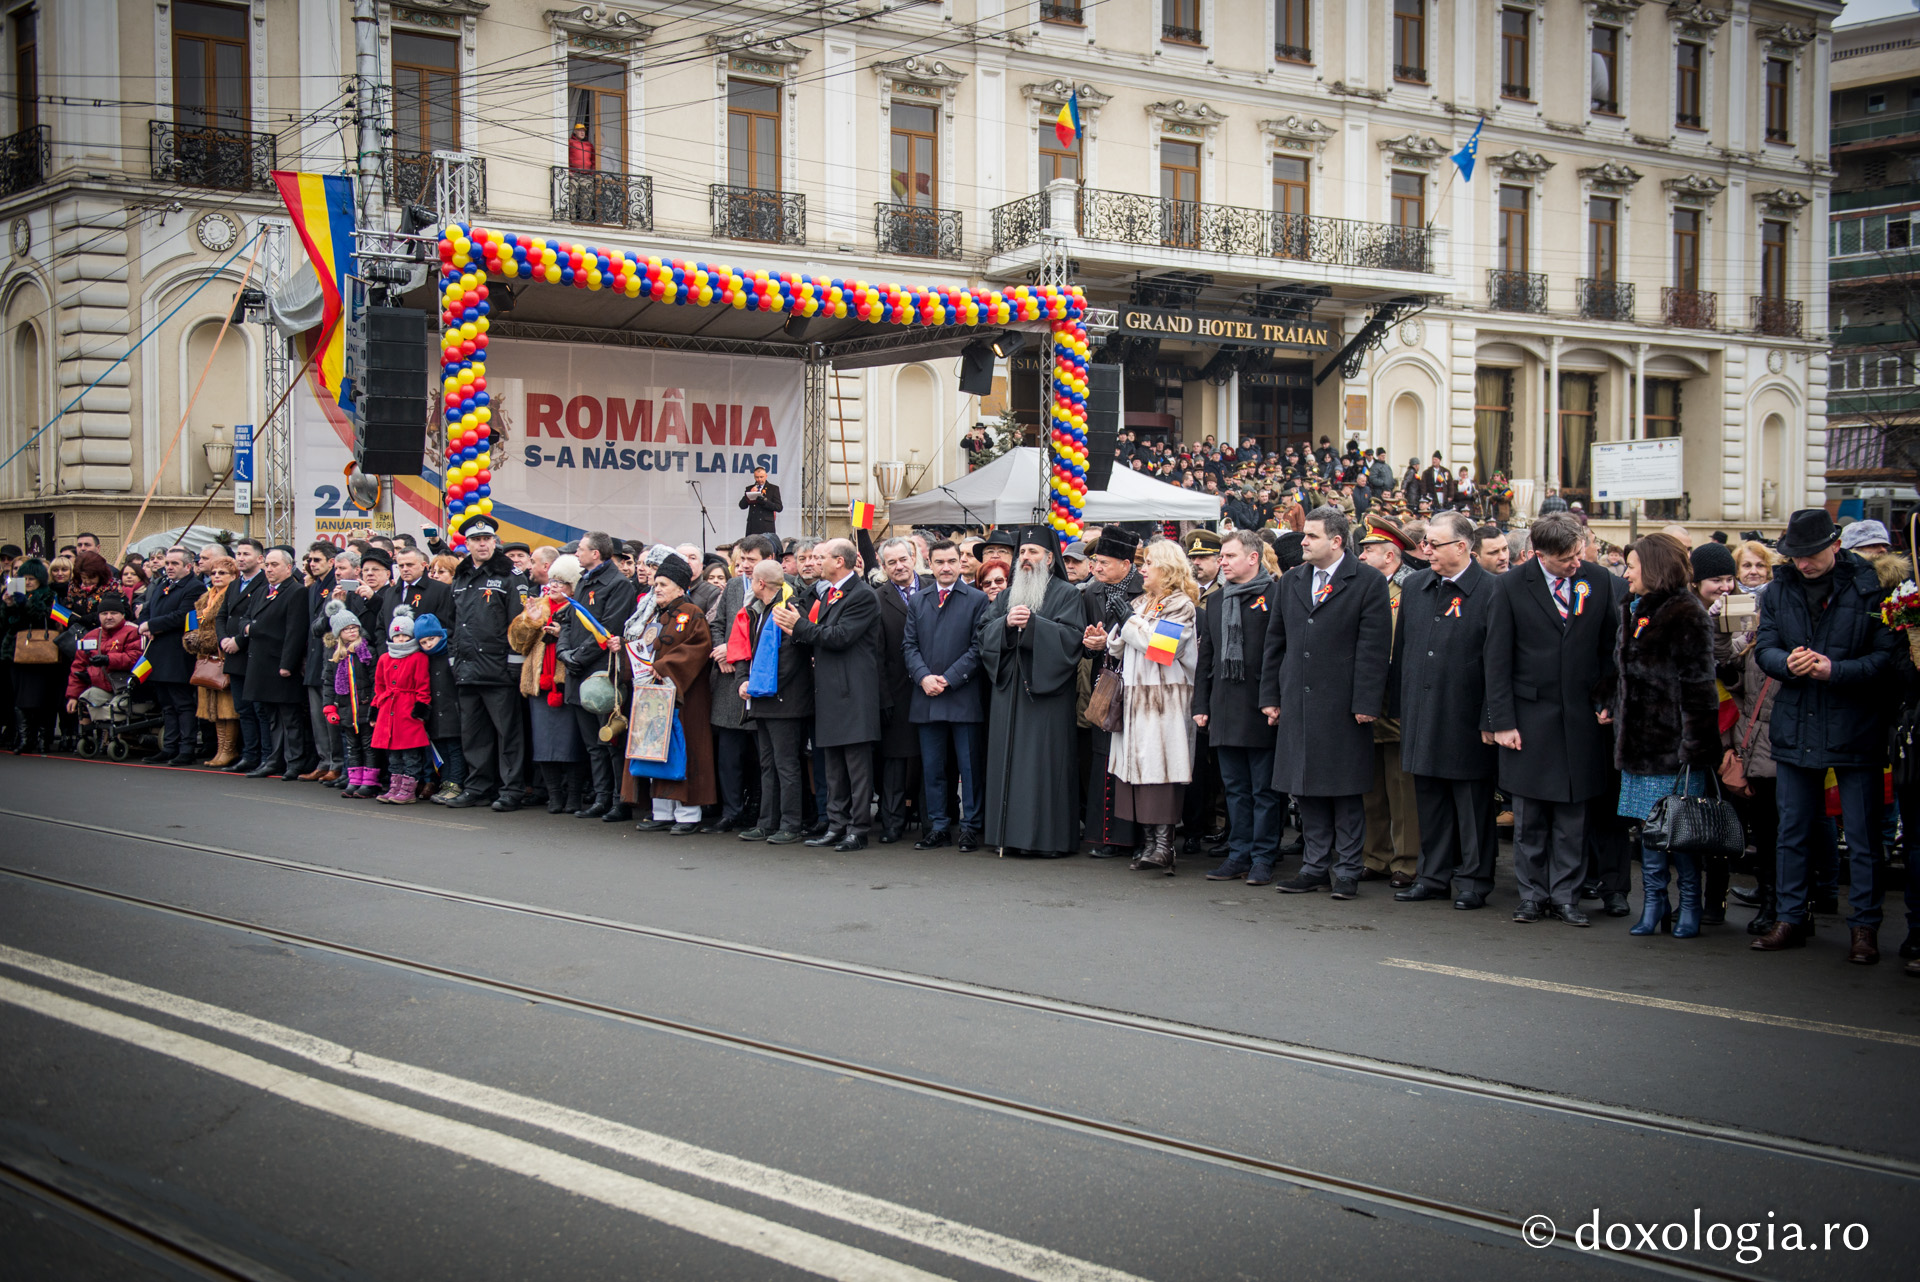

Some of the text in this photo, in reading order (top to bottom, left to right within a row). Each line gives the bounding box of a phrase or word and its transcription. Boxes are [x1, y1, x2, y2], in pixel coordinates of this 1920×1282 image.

[1125, 311, 1328, 346] GRAND HOTEL TRAIAN
[526, 387, 777, 447] ROMÂNIA
[524, 444, 576, 469] S-A
[583, 441, 689, 472] NĂSCUT
[696, 452, 726, 473] LA
[317, 521, 372, 530] IANUARIE
